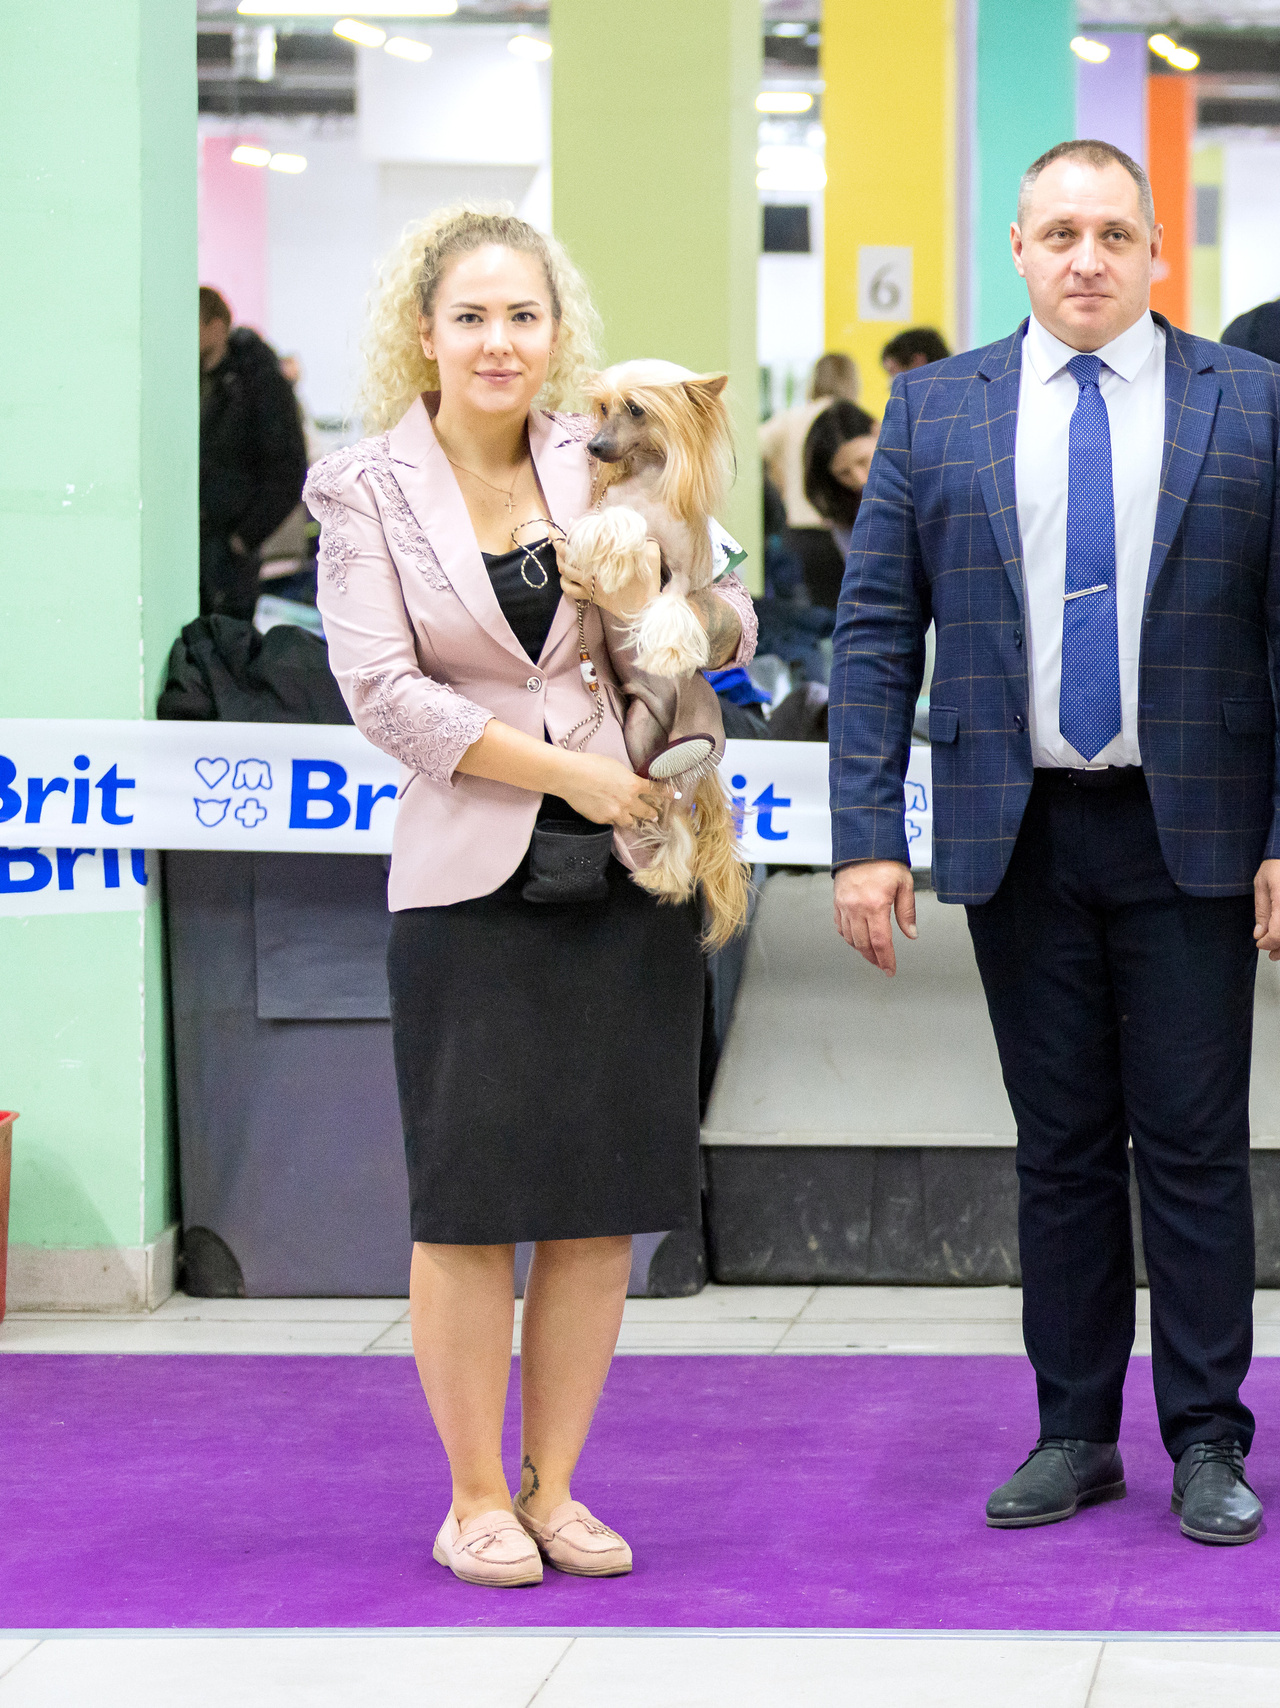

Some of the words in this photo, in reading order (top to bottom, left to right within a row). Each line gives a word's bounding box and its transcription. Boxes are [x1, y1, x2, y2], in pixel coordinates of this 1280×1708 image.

[869, 261, 901, 312] 6
[288, 758, 399, 831] Br
[731, 774, 792, 841] it
